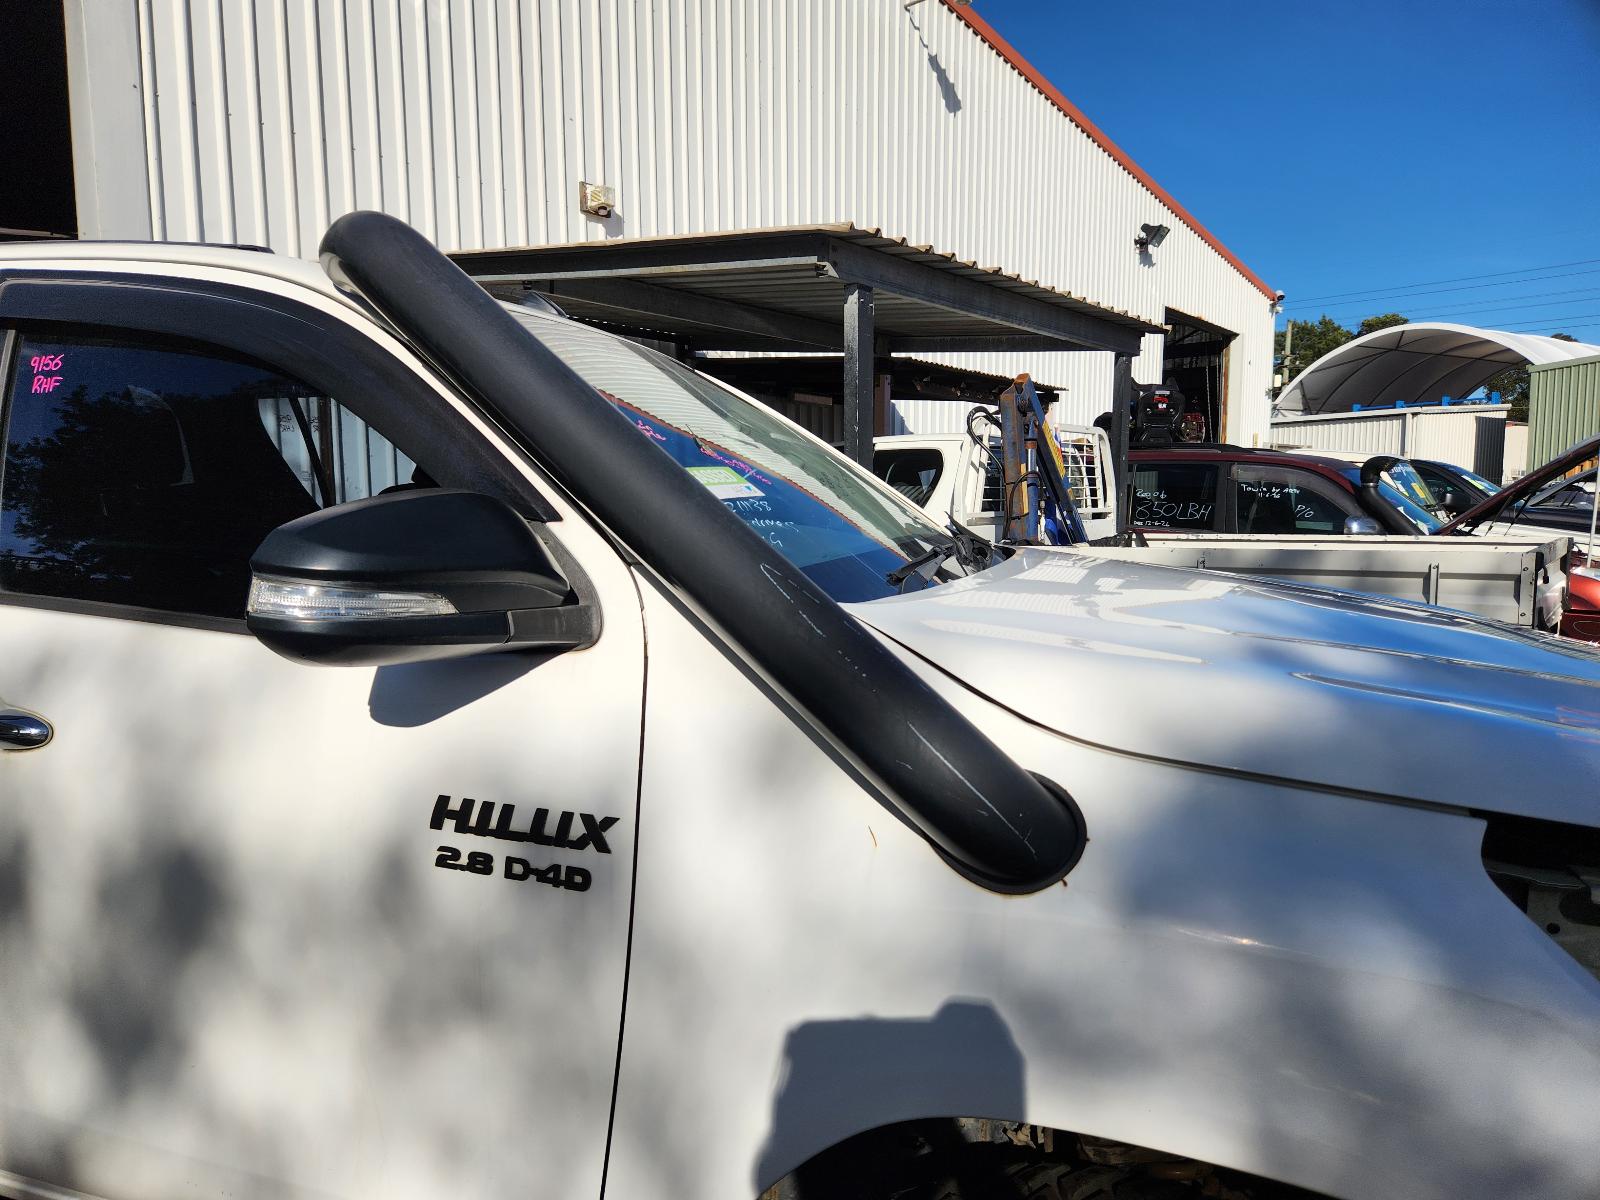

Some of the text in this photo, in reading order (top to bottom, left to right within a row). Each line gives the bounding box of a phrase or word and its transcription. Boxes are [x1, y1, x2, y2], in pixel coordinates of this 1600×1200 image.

[30, 353, 65, 374] 9156
[31, 375, 64, 394] RHF
[1135, 500, 1212, 521] 850LBH
[429, 795, 620, 854] HILUX
[434, 845, 592, 892] 2.8 D-4D
